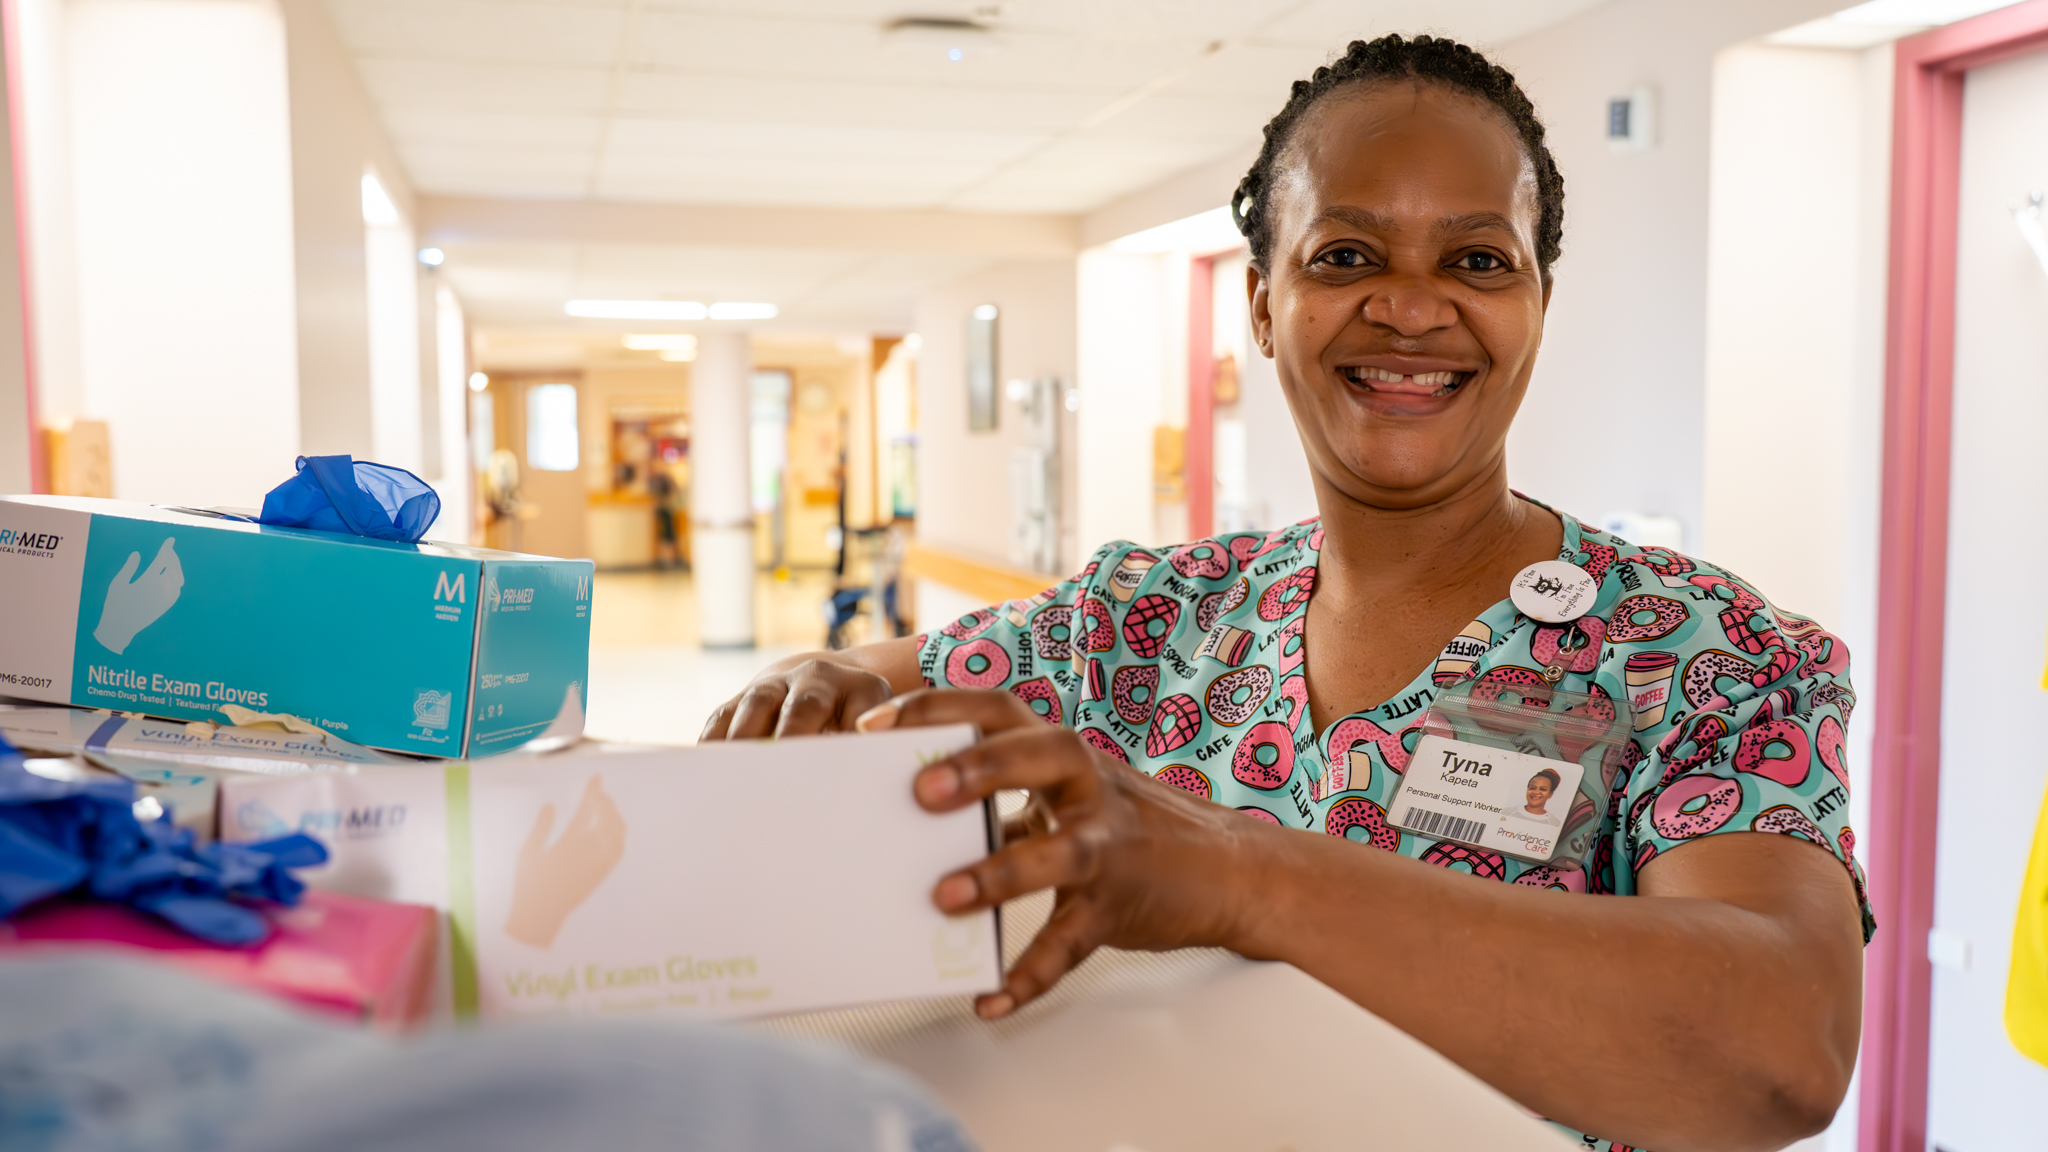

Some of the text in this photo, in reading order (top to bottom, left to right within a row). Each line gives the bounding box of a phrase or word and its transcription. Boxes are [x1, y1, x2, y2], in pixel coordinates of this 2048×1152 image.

[17, 549, 54, 559] PRODUCTS
[433, 570, 466, 604] M
[1523, 569, 1536, 579] Fine
[576, 575, 589, 601] M
[1092, 585, 1118, 612] CAFE
[1162, 576, 1200, 603] MOCHA
[1558, 592, 1583, 617] Everything
[1579, 577, 1592, 587] Fine
[1562, 583, 1575, 594] Fine
[1018, 631, 1033, 677] COFFEE
[1202, 627, 1223, 654] COFFEE
[1445, 640, 1486, 657] COFFEE
[88, 664, 269, 707] Nitrile Exam Gloves
[1053, 669, 1078, 692] CAFE
[1381, 688, 1434, 720] LATTE
[1634, 686, 1665, 708] COFFEE
[139, 692, 166, 705] Tested
[176, 698, 211, 711] Textured
[322, 718, 349, 731] Purple
[1105, 710, 1142, 748] LATTE
[141, 728, 202, 743] Viny
[211, 732, 277, 747] Exam
[284, 741, 364, 761] Gloves
[1195, 734, 1233, 761] CAFE
[1441, 750, 1493, 777] Tyna
[1440, 772, 1479, 789] Kapeta
[1290, 780, 1315, 829] LATTE
[1405, 786, 1502, 815] Personal Support Worker
[1808, 786, 1847, 822] LATTE
[1496, 827, 1551, 847] Providence
[1525, 842, 1548, 855] Care
[504, 954, 758, 1003] Vinyl Exam Gloves
